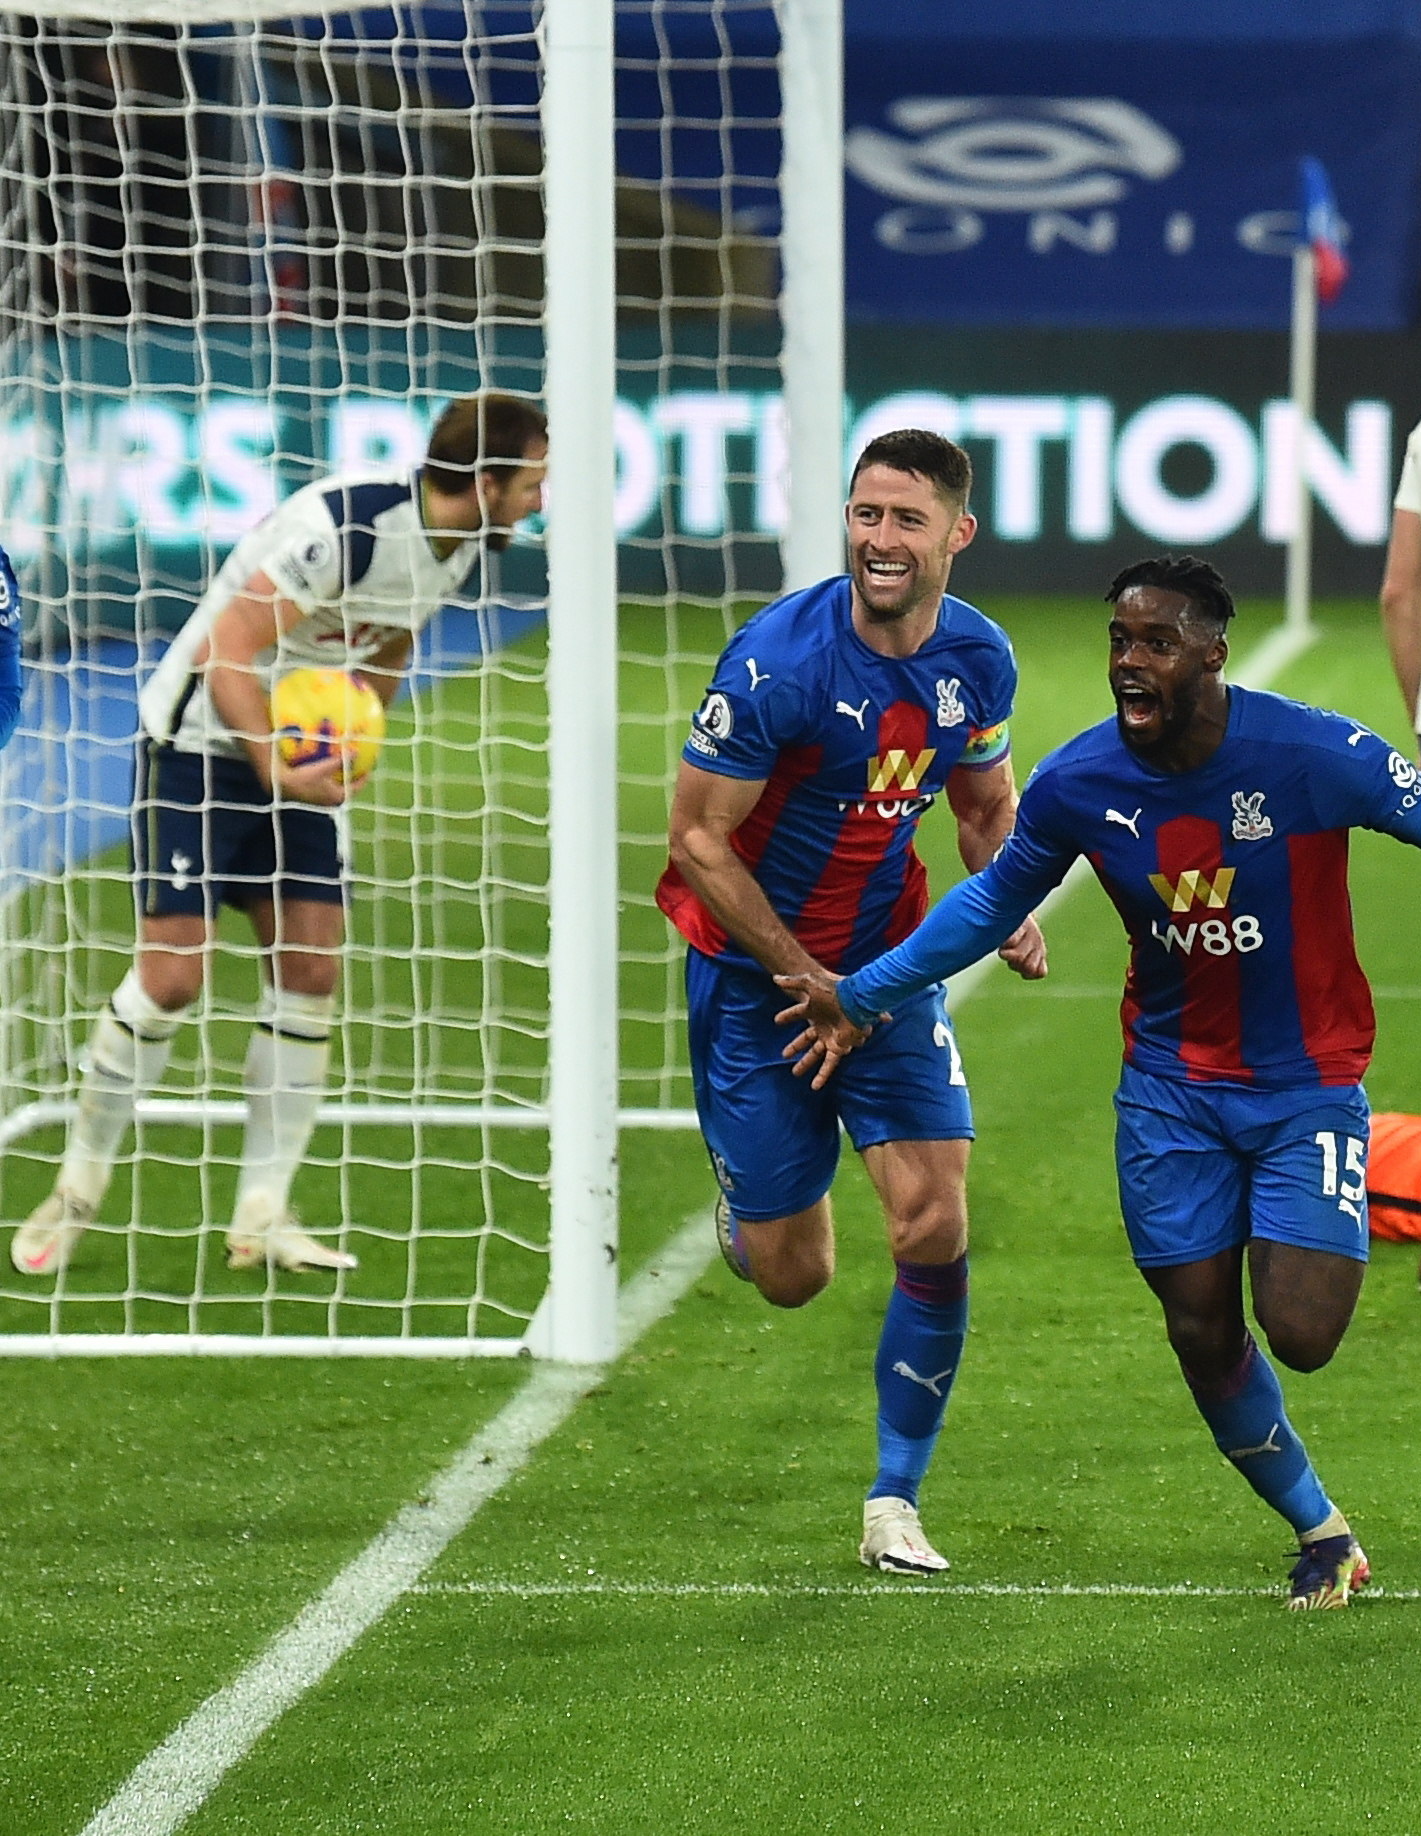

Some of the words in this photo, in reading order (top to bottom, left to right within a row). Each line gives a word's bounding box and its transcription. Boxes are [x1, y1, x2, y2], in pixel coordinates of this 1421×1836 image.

[334, 390, 1392, 545] PTTION
[1152, 915, 1264, 956] W88
[1315, 1132, 1366, 1201] 15
